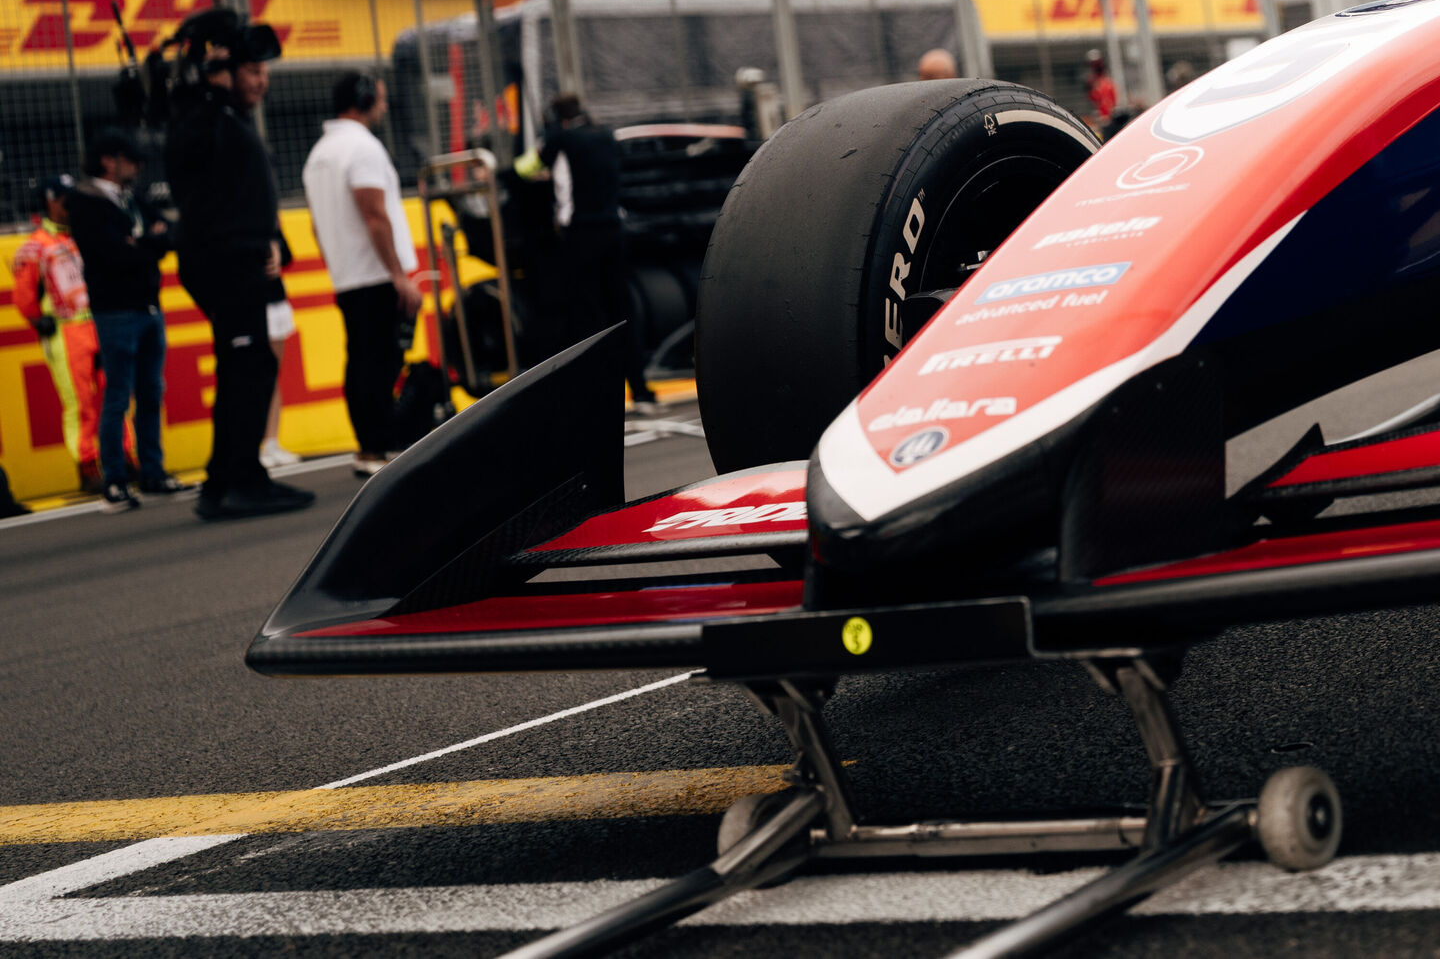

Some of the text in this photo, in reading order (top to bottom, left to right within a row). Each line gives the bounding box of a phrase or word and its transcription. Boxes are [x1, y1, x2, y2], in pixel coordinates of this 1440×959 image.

[884, 197, 925, 369] ERO
[985, 266, 1119, 301] aramco
[954, 289, 1109, 327] advanced fuel
[916, 334, 1063, 376] PIRELLI
[867, 397, 1018, 433] dallara
